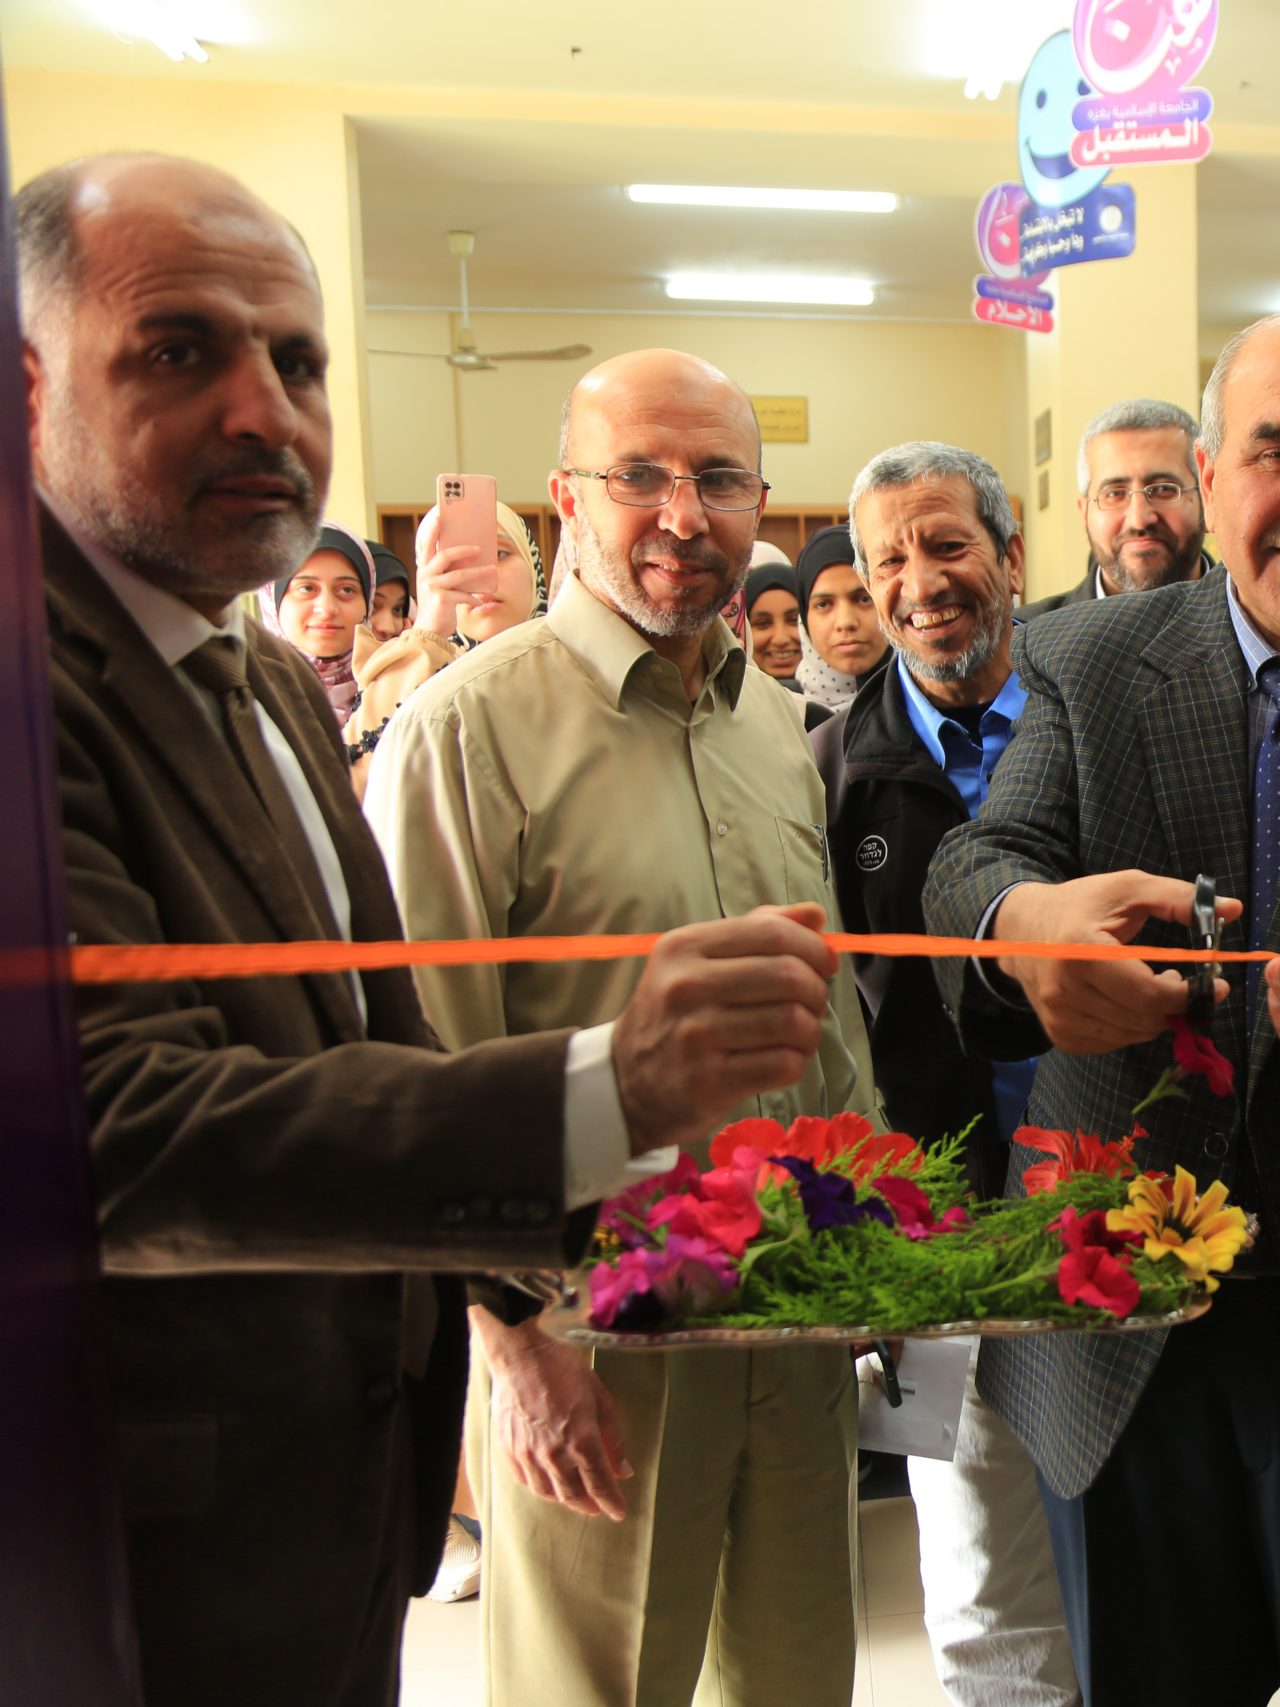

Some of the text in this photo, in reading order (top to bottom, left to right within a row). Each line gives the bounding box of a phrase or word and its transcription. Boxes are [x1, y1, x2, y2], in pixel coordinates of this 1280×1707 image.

[1159, 98, 1199, 116] الجامعة
[1081, 117, 1199, 162] المستقبل
[863, 842, 877, 851] קפה
